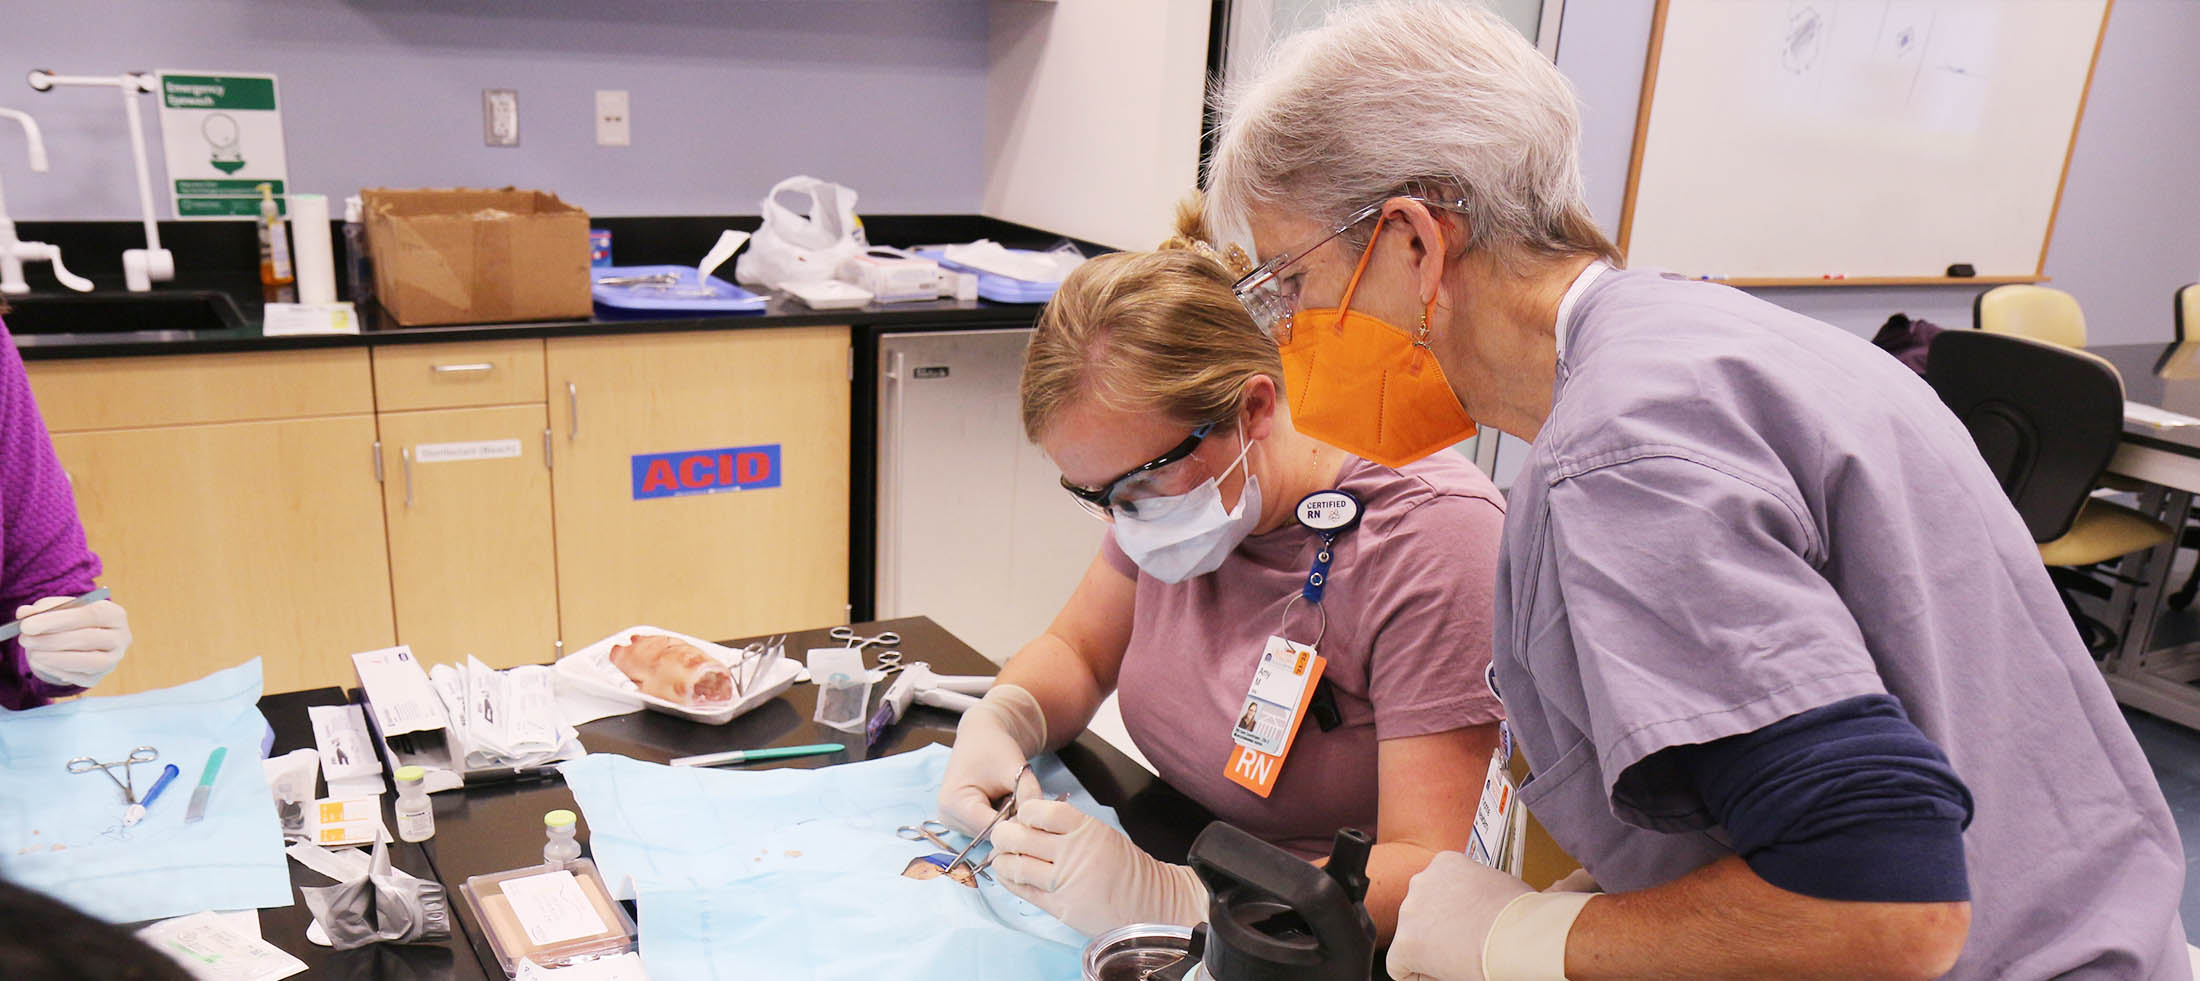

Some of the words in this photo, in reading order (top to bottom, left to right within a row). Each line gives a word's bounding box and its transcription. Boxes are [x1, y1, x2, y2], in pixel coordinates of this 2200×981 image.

[166, 82, 225, 97] Emergency
[642, 452, 771, 493] ACID
[1306, 500, 1346, 510] CERTIFIED
[1307, 509, 1321, 519] RN
[1235, 747, 1275, 786] RN
